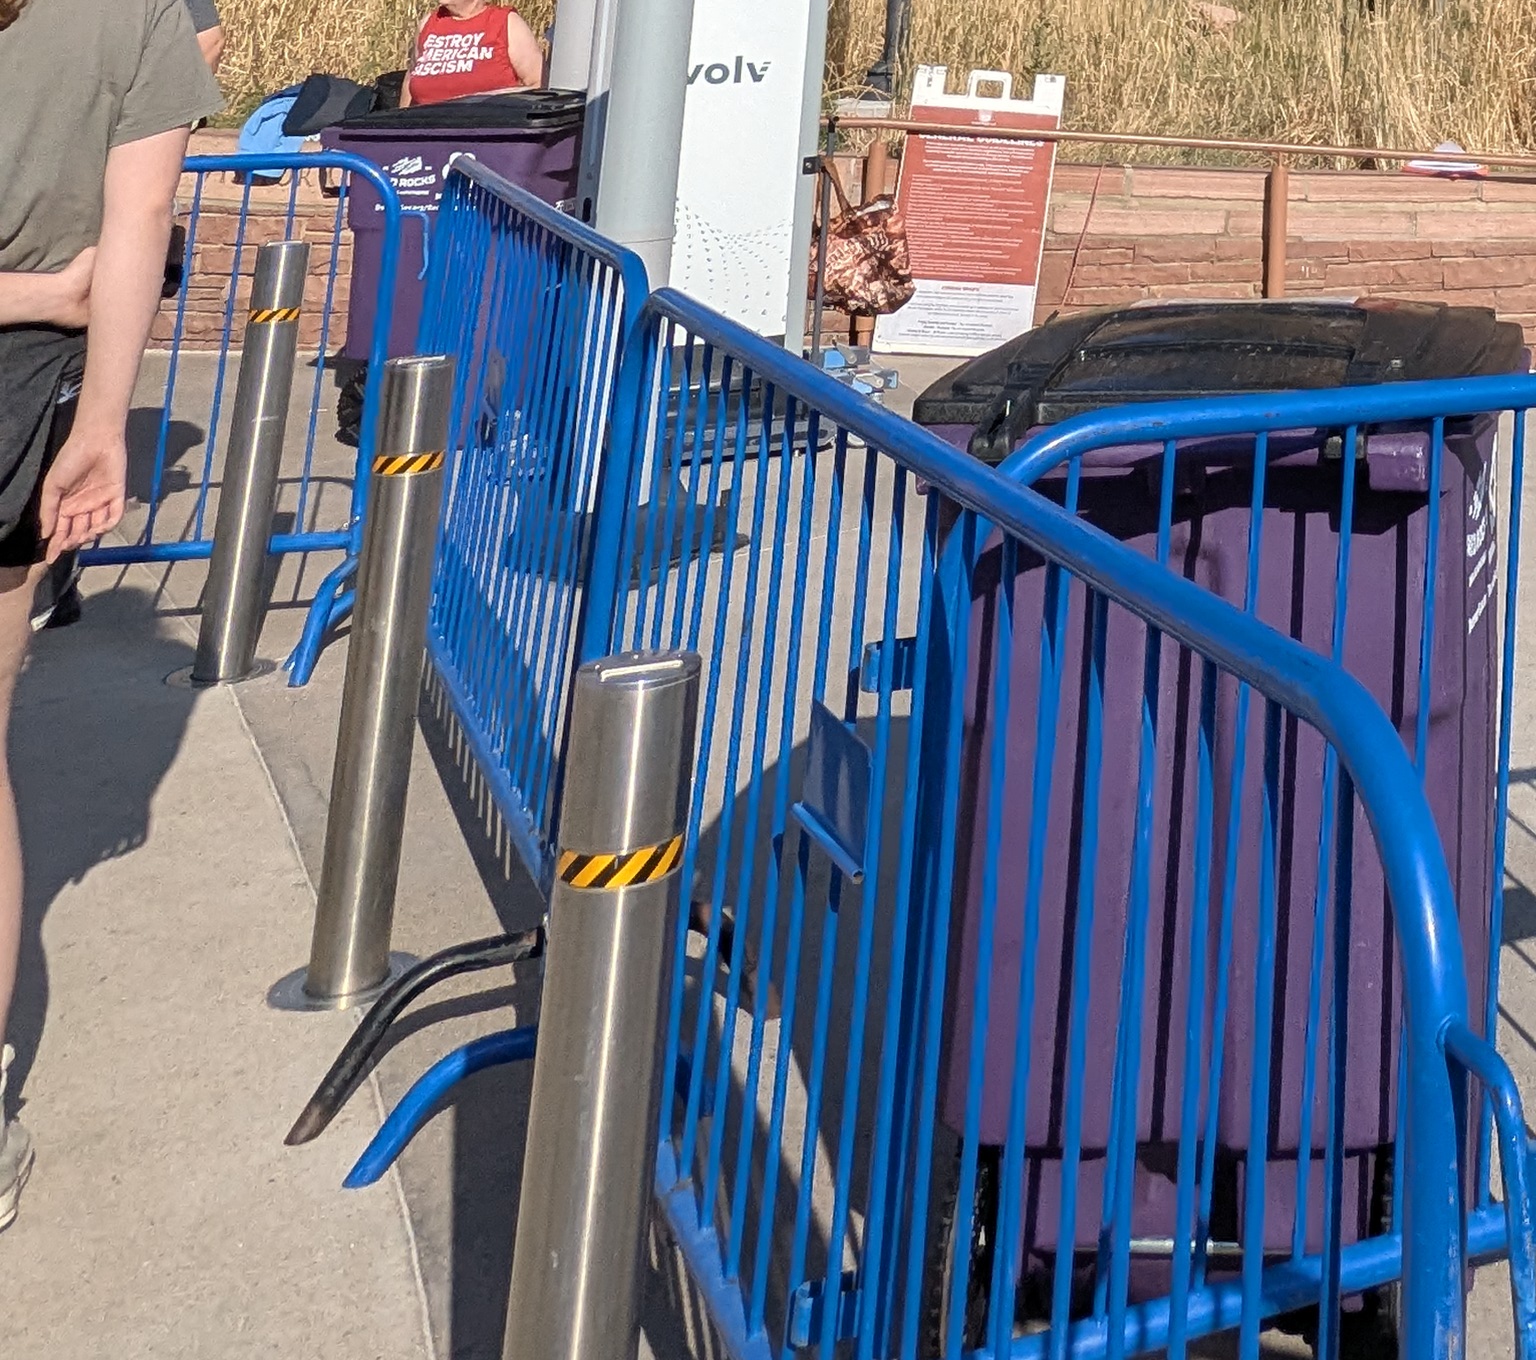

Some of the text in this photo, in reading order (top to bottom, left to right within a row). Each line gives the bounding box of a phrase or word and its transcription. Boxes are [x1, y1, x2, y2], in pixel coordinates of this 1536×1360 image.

[423, 32, 485, 49] ESTROY
[411, 59, 474, 76] ASCISM
[687, 55, 772, 85] volv
